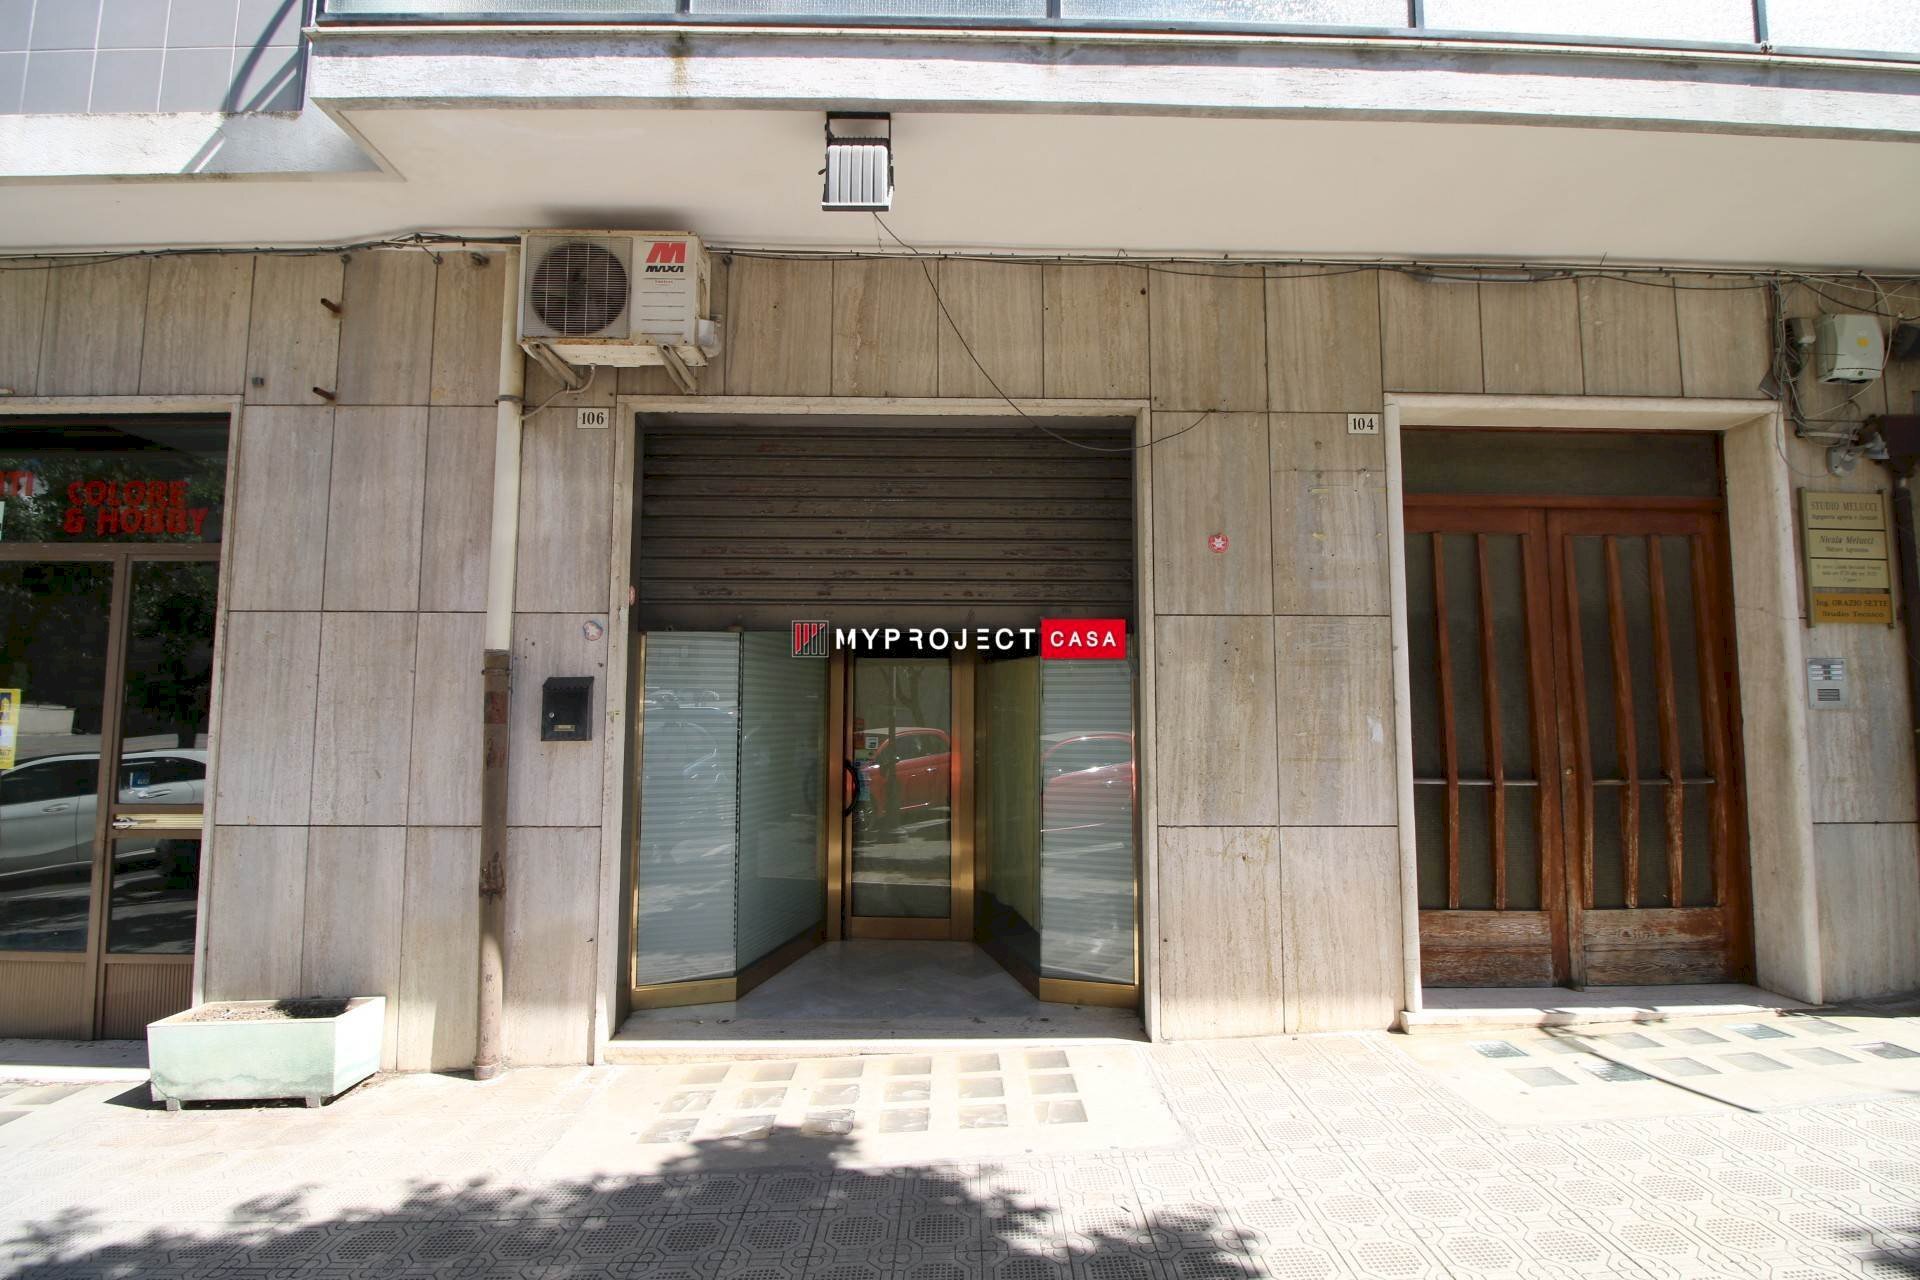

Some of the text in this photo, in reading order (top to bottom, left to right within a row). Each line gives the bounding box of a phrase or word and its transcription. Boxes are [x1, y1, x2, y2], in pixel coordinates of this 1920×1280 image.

[645, 265, 684, 273] MAXA
[581, 411, 605, 425] 106
[1353, 417, 1374, 430] 104
[67, 480, 190, 508] COLORE
[1811, 501, 1878, 513] STUDIO MELUCCI
[64, 507, 209, 536] & HOBBY
[1845, 536, 1875, 545] Melucci
[1863, 600, 1889, 608] SETTE
